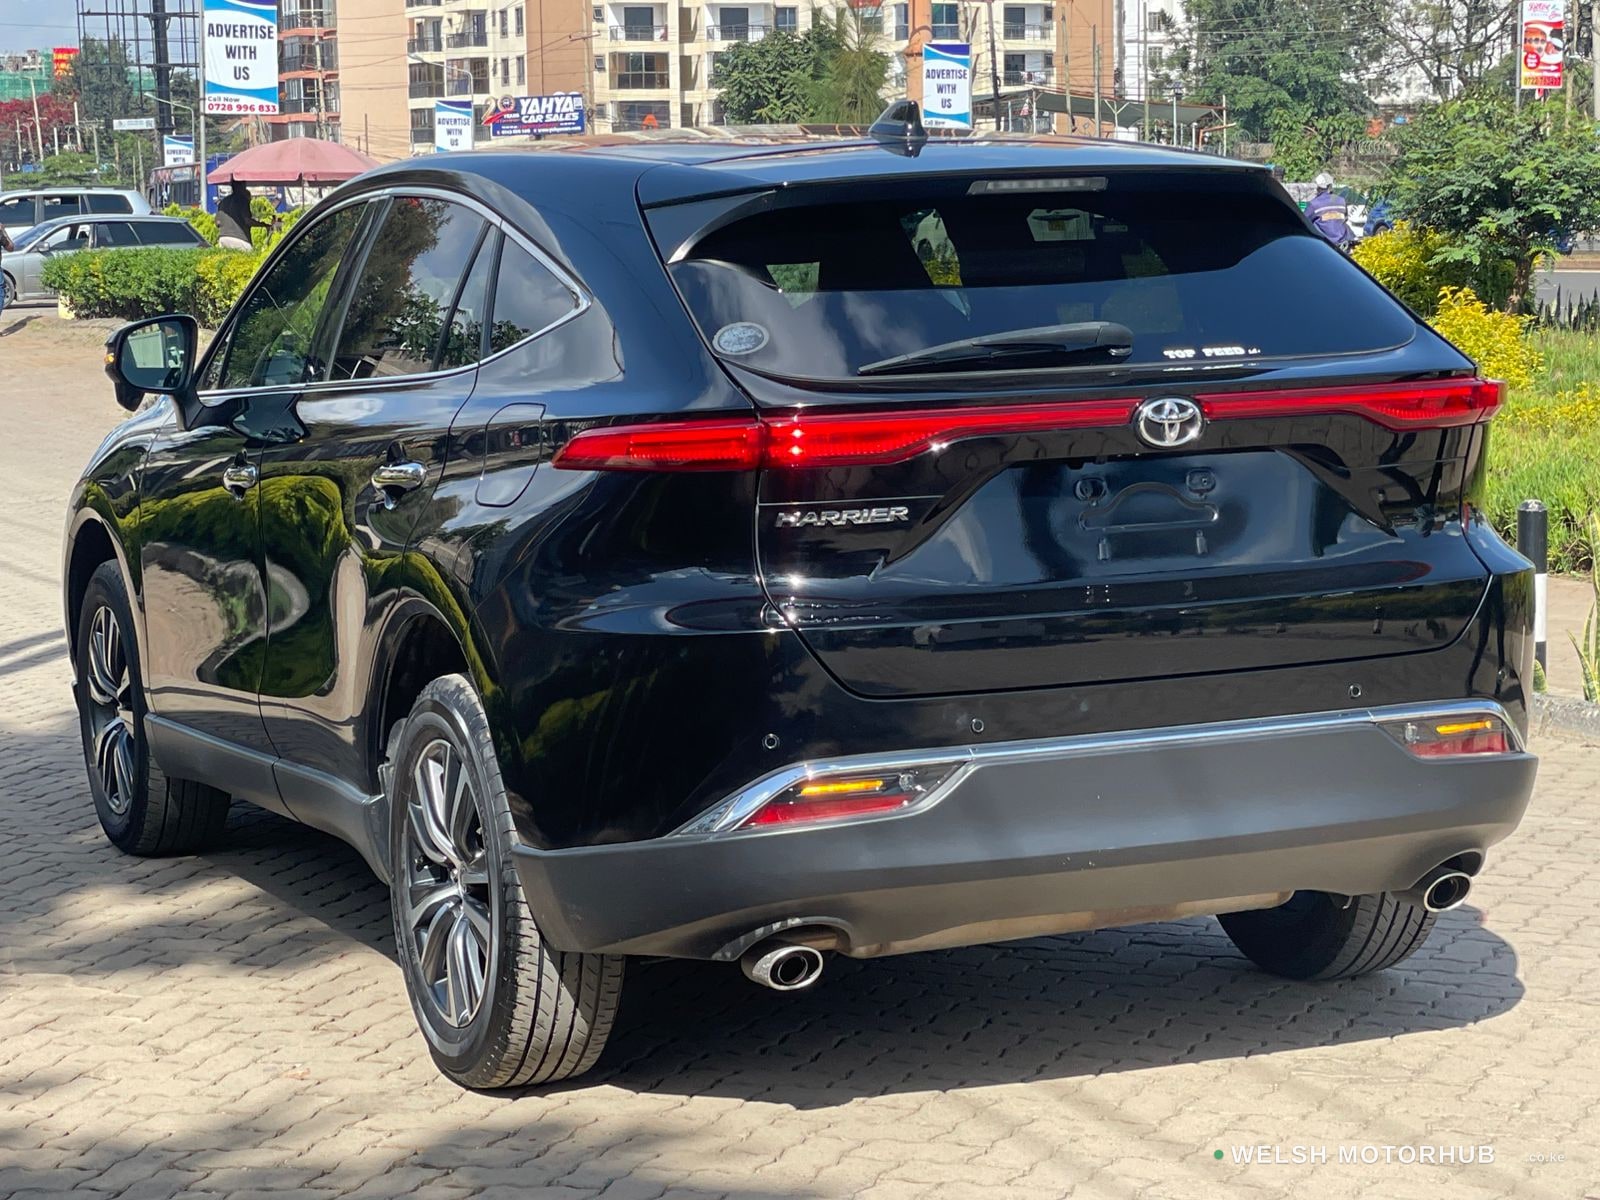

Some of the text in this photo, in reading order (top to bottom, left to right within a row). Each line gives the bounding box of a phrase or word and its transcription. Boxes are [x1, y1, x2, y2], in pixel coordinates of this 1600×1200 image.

[207, 23, 275, 40] ADVERTISE
[225, 44, 257, 60] WITH
[233, 65, 250, 80] US
[925, 69, 967, 79] ADVERTISE
[936, 83, 957, 94] WITH
[207, 103, 277, 113] 0728 996 833
[520, 96, 575, 116] YAHYA
[941, 98, 952, 109] US
[437, 117, 471, 126] ADVERTISE
[521, 114, 543, 123] CAR
[545, 112, 579, 122] SALES
[446, 128, 463, 136] WITH
[450, 138, 459, 147] US
[1163, 348, 1196, 359] TOP
[775, 506, 909, 527] HARRIER
